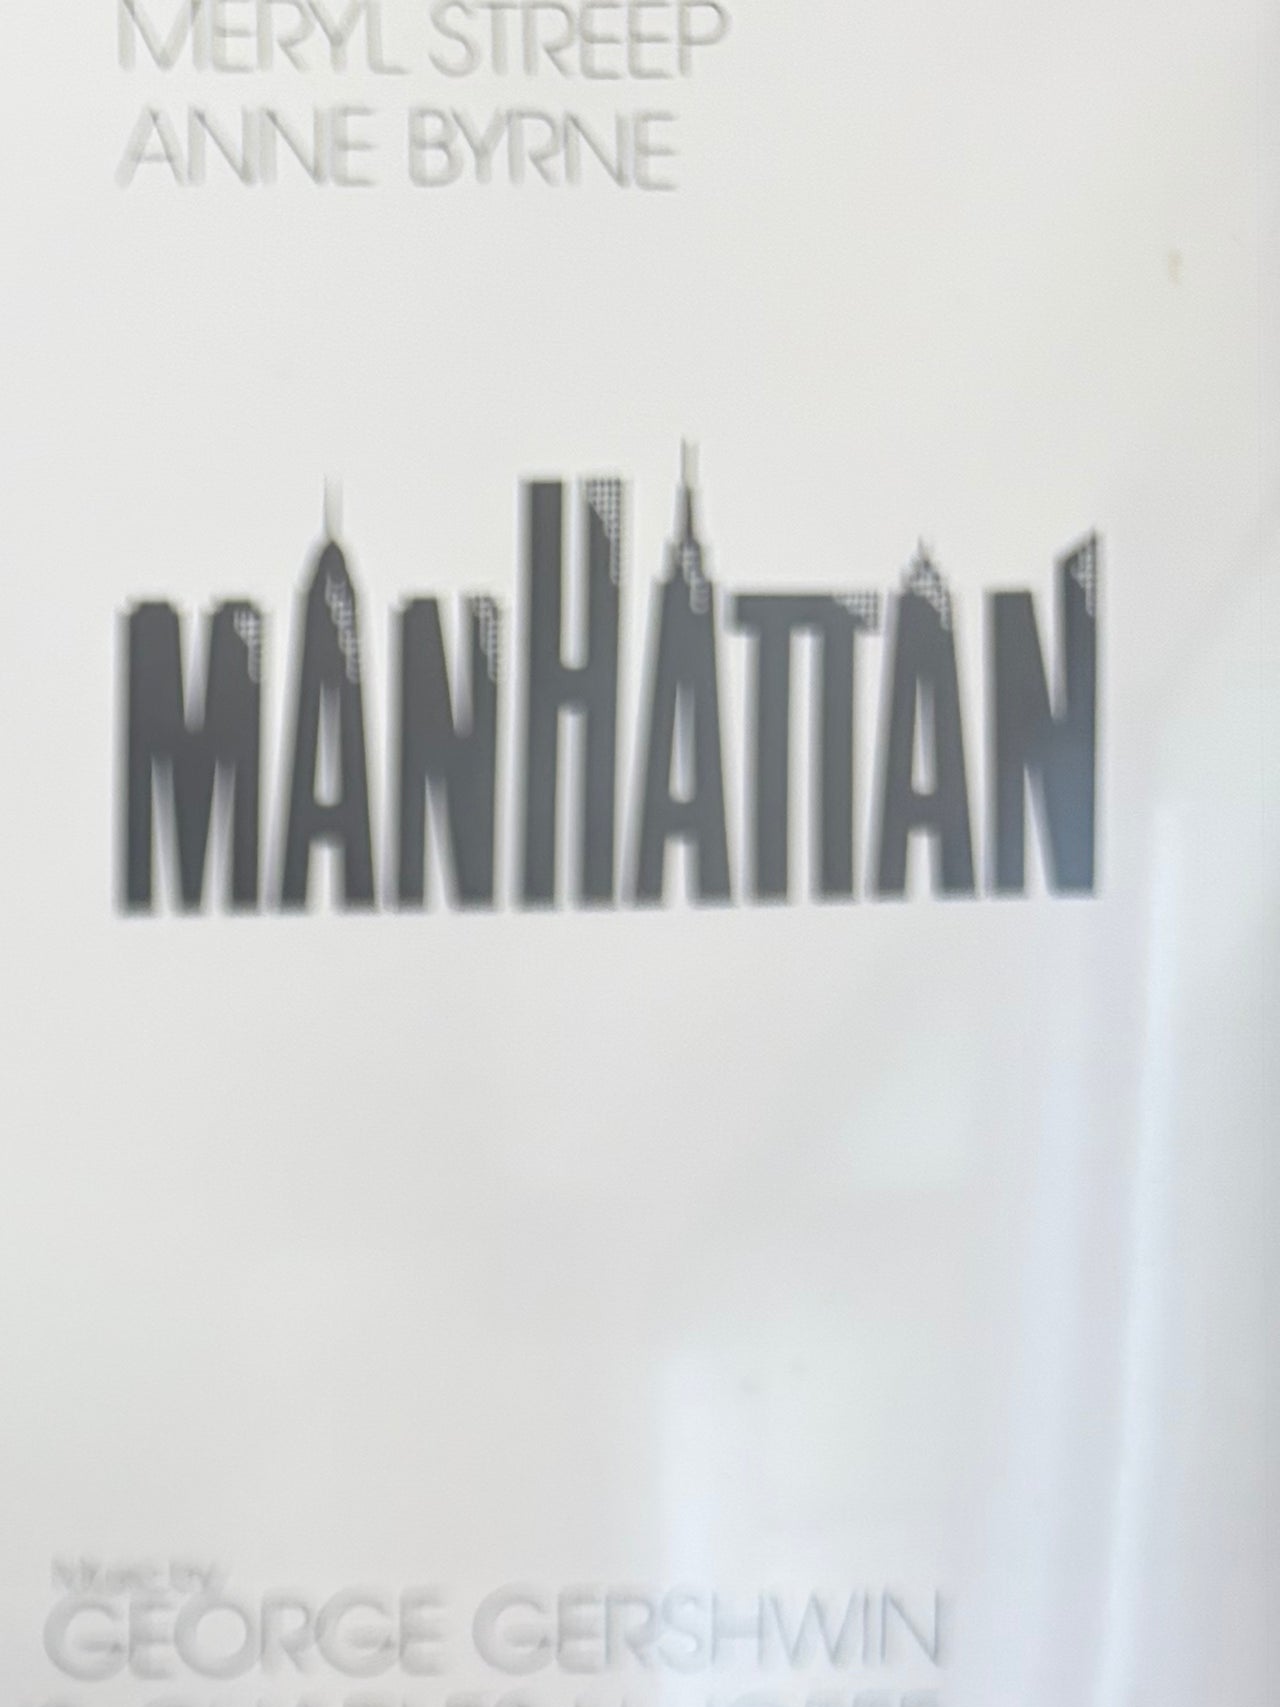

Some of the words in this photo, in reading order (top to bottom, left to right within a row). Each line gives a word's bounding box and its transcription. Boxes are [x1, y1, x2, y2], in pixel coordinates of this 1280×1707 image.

[116, 0, 411, 75] MERYL
[428, 0, 731, 80] STREEP
[114, 104, 378, 189] ANNE
[408, 104, 680, 191] BYRNE
[113, 436, 1104, 918] MANHATTAN
[42, 1582, 448, 1684] GEORGE
[472, 1580, 950, 1676] GERSHWIN
